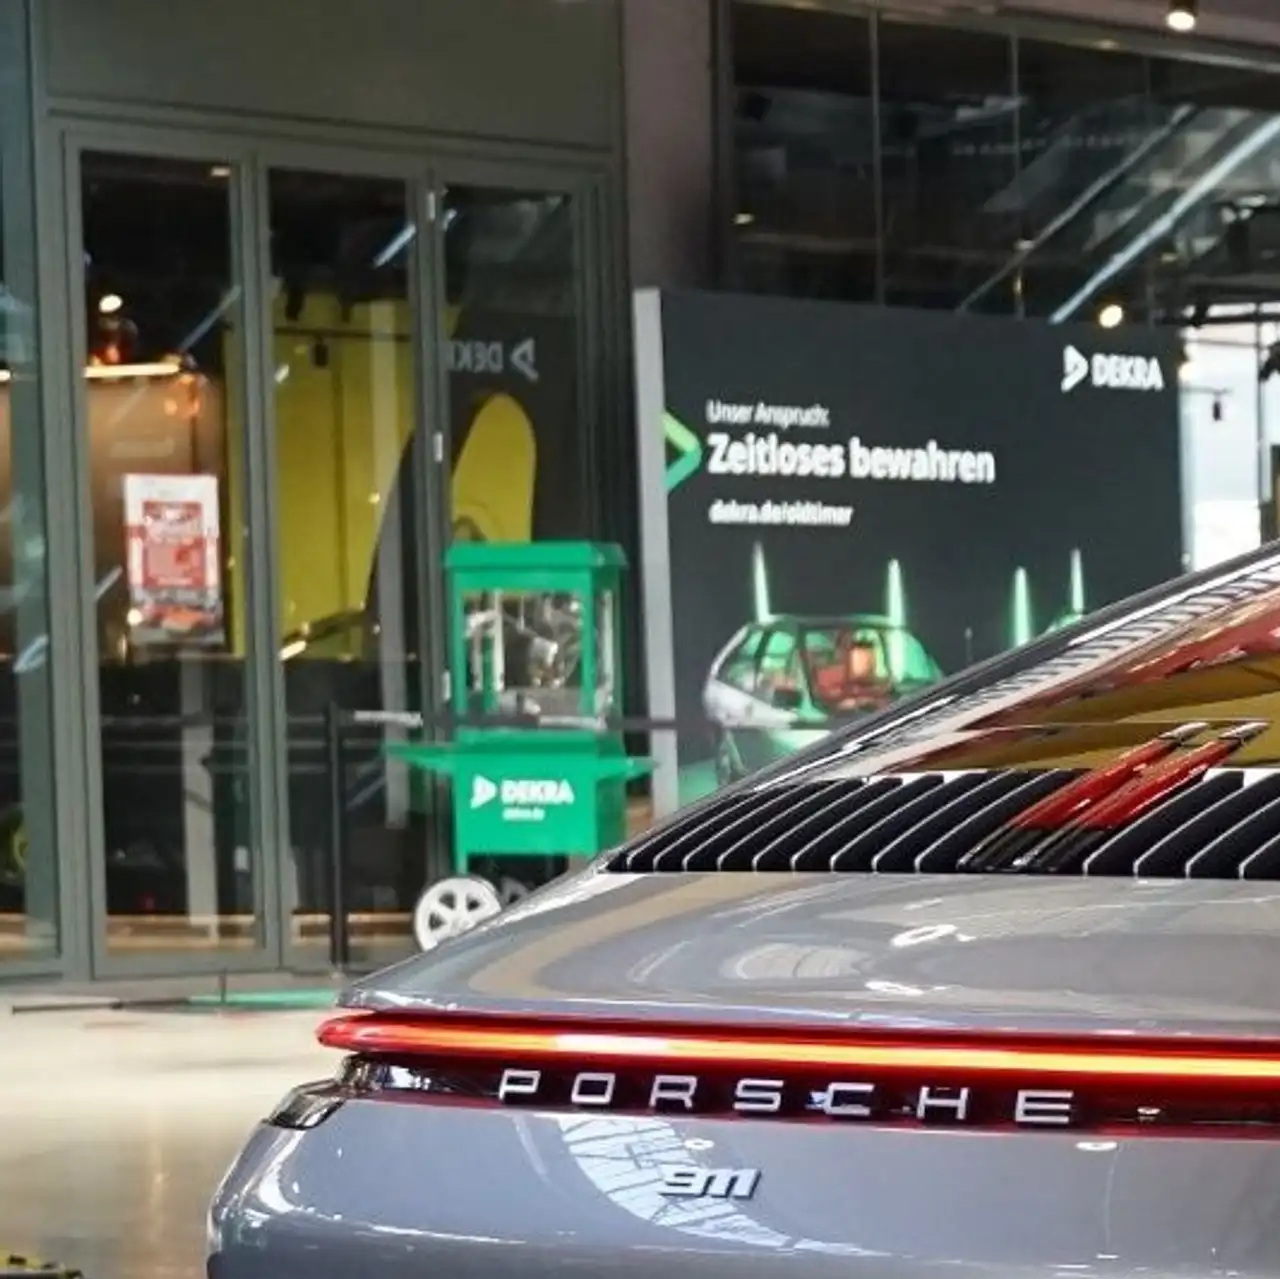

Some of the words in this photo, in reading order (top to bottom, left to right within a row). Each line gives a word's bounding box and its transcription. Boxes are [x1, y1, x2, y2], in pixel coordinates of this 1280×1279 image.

[1091, 354, 1163, 390] DEKRA
[706, 400, 752, 425] Unser
[707, 432, 846, 477] Zeitloses
[849, 436, 996, 483] bewahren
[501, 779, 575, 805] DEKRA
[499, 1069, 1075, 1125] PORSCHE
[662, 1166, 762, 1200] 911
